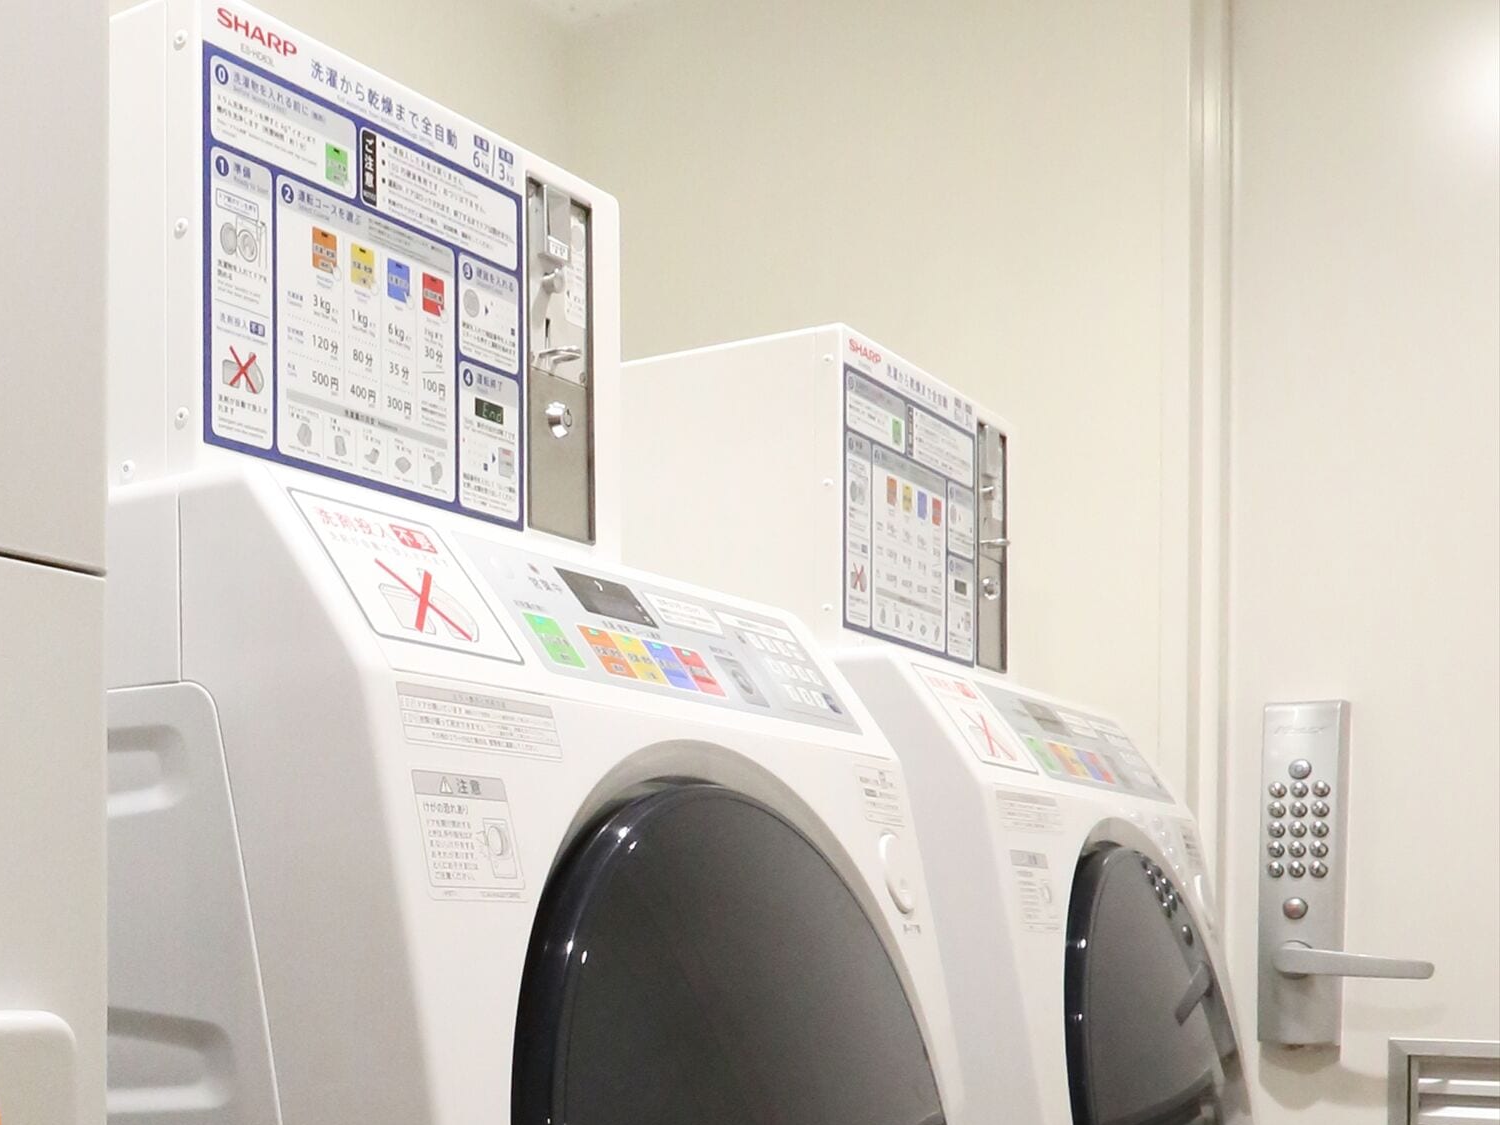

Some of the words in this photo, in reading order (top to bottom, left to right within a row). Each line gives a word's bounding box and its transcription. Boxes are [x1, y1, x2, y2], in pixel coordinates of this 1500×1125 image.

[217, 7, 297, 57] SHARP
[311, 59, 458, 150] 洗濯から乾燥まで全自動
[312, 334, 338, 355] 120分
[849, 338, 882, 363] SHARP
[353, 349, 373, 367] 80分
[424, 346, 443, 364] 30分
[389, 361, 410, 380] 35分
[311, 371, 339, 392] 500円
[422, 378, 446, 398] 100円
[350, 384, 376, 403] 400円
[387, 396, 412, 416] 300円
